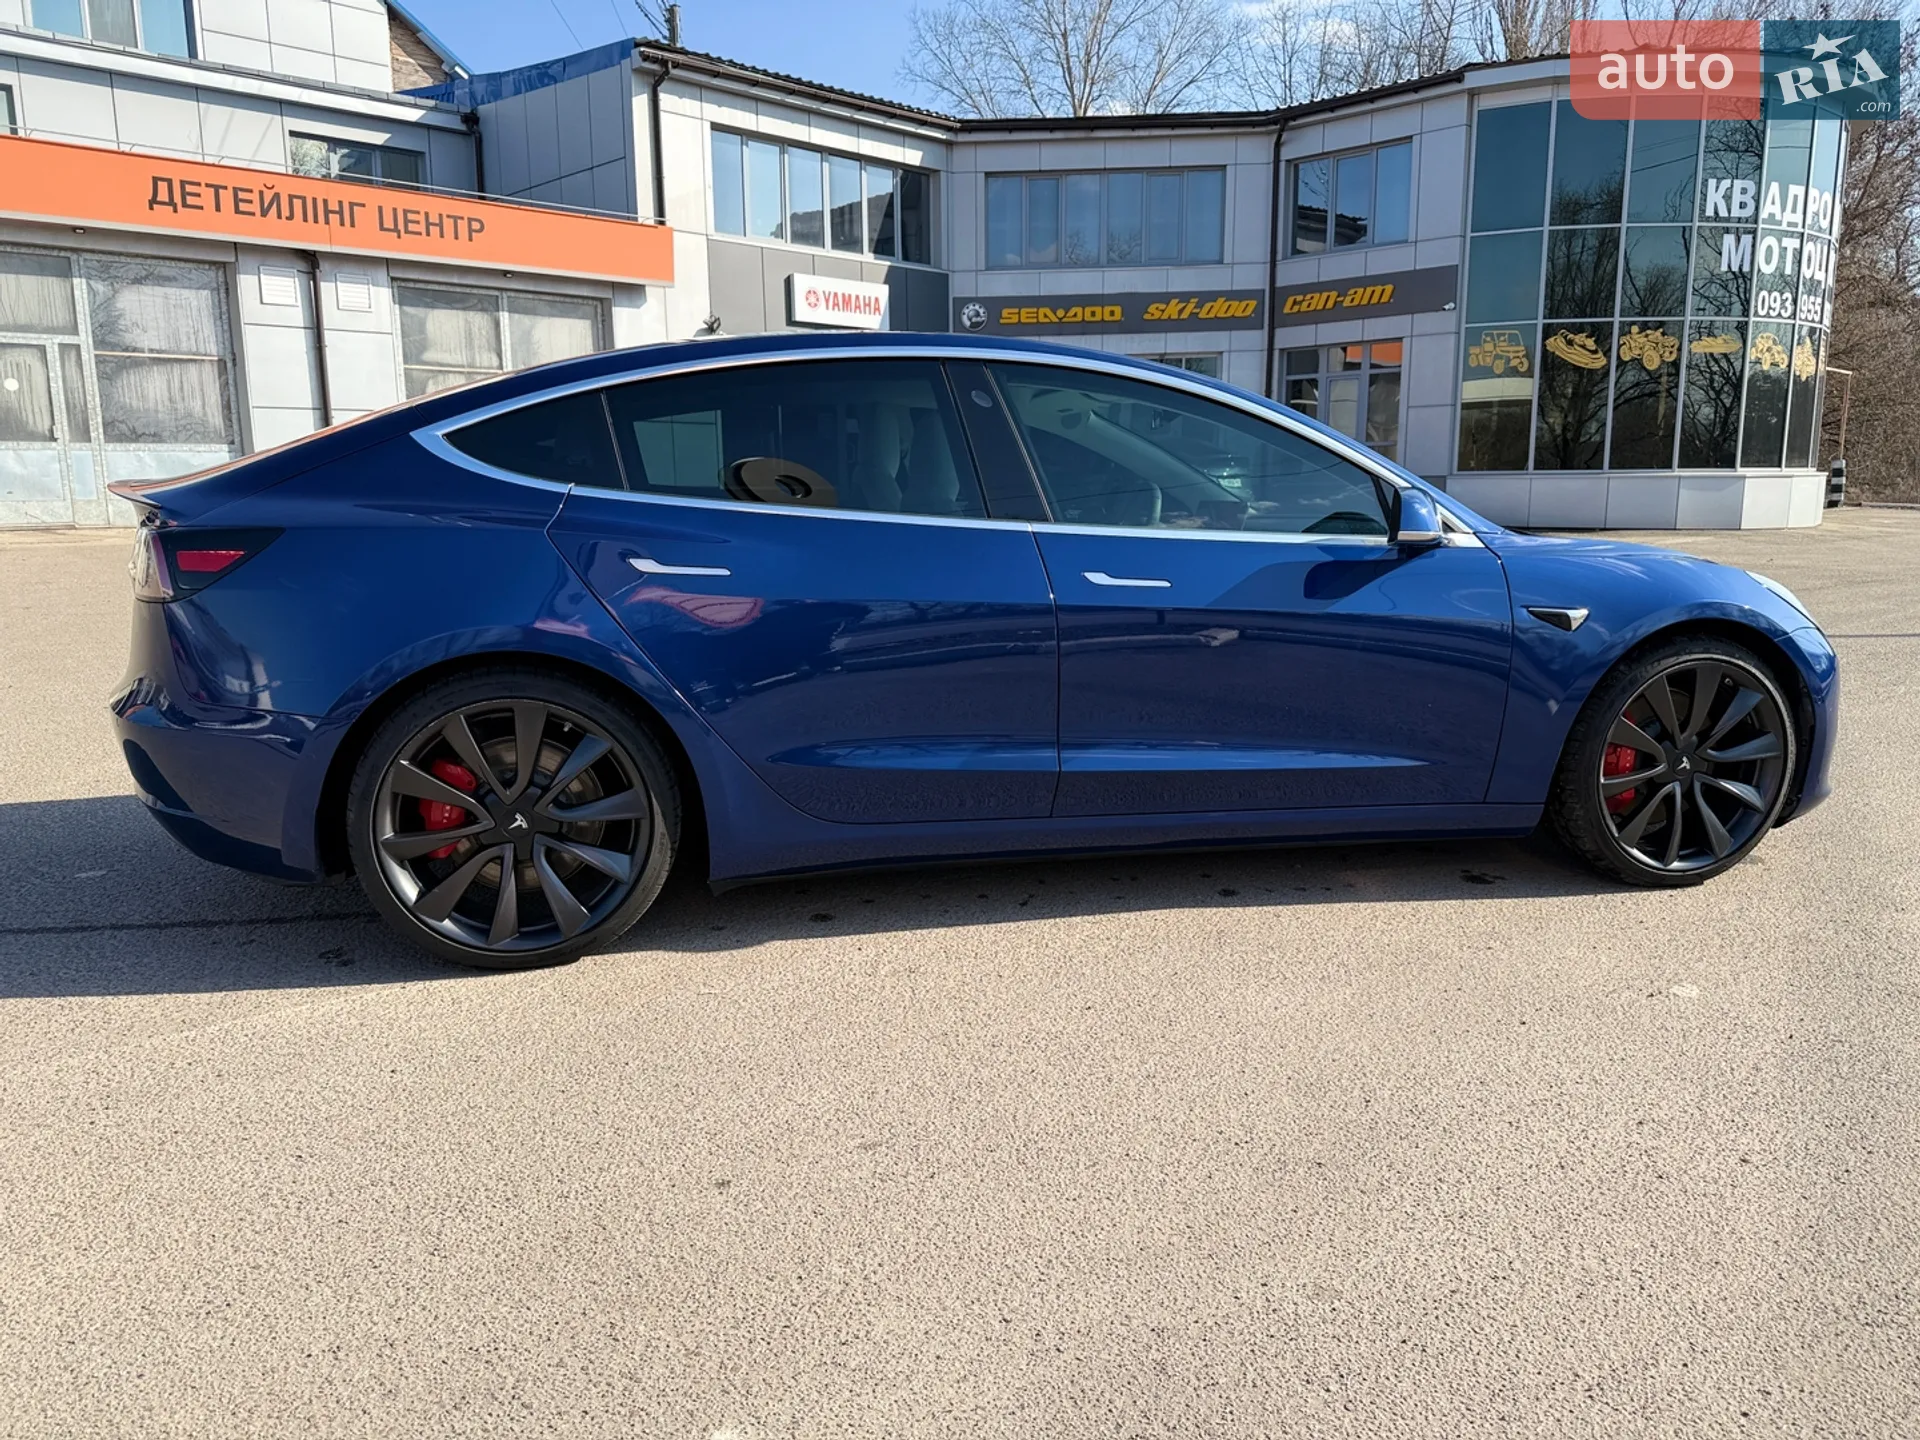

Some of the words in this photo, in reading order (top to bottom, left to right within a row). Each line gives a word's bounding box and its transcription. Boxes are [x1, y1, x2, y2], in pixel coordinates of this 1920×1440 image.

[147, 175, 367, 229] ДЕТЕЙЛІНГ
[377, 204, 486, 243] ЦЕНТР
[822, 289, 882, 316] YAMAHA
[1282, 283, 1395, 315] can-am
[1756, 289, 1793, 318] 093
[1800, 294, 1822, 322] 955
